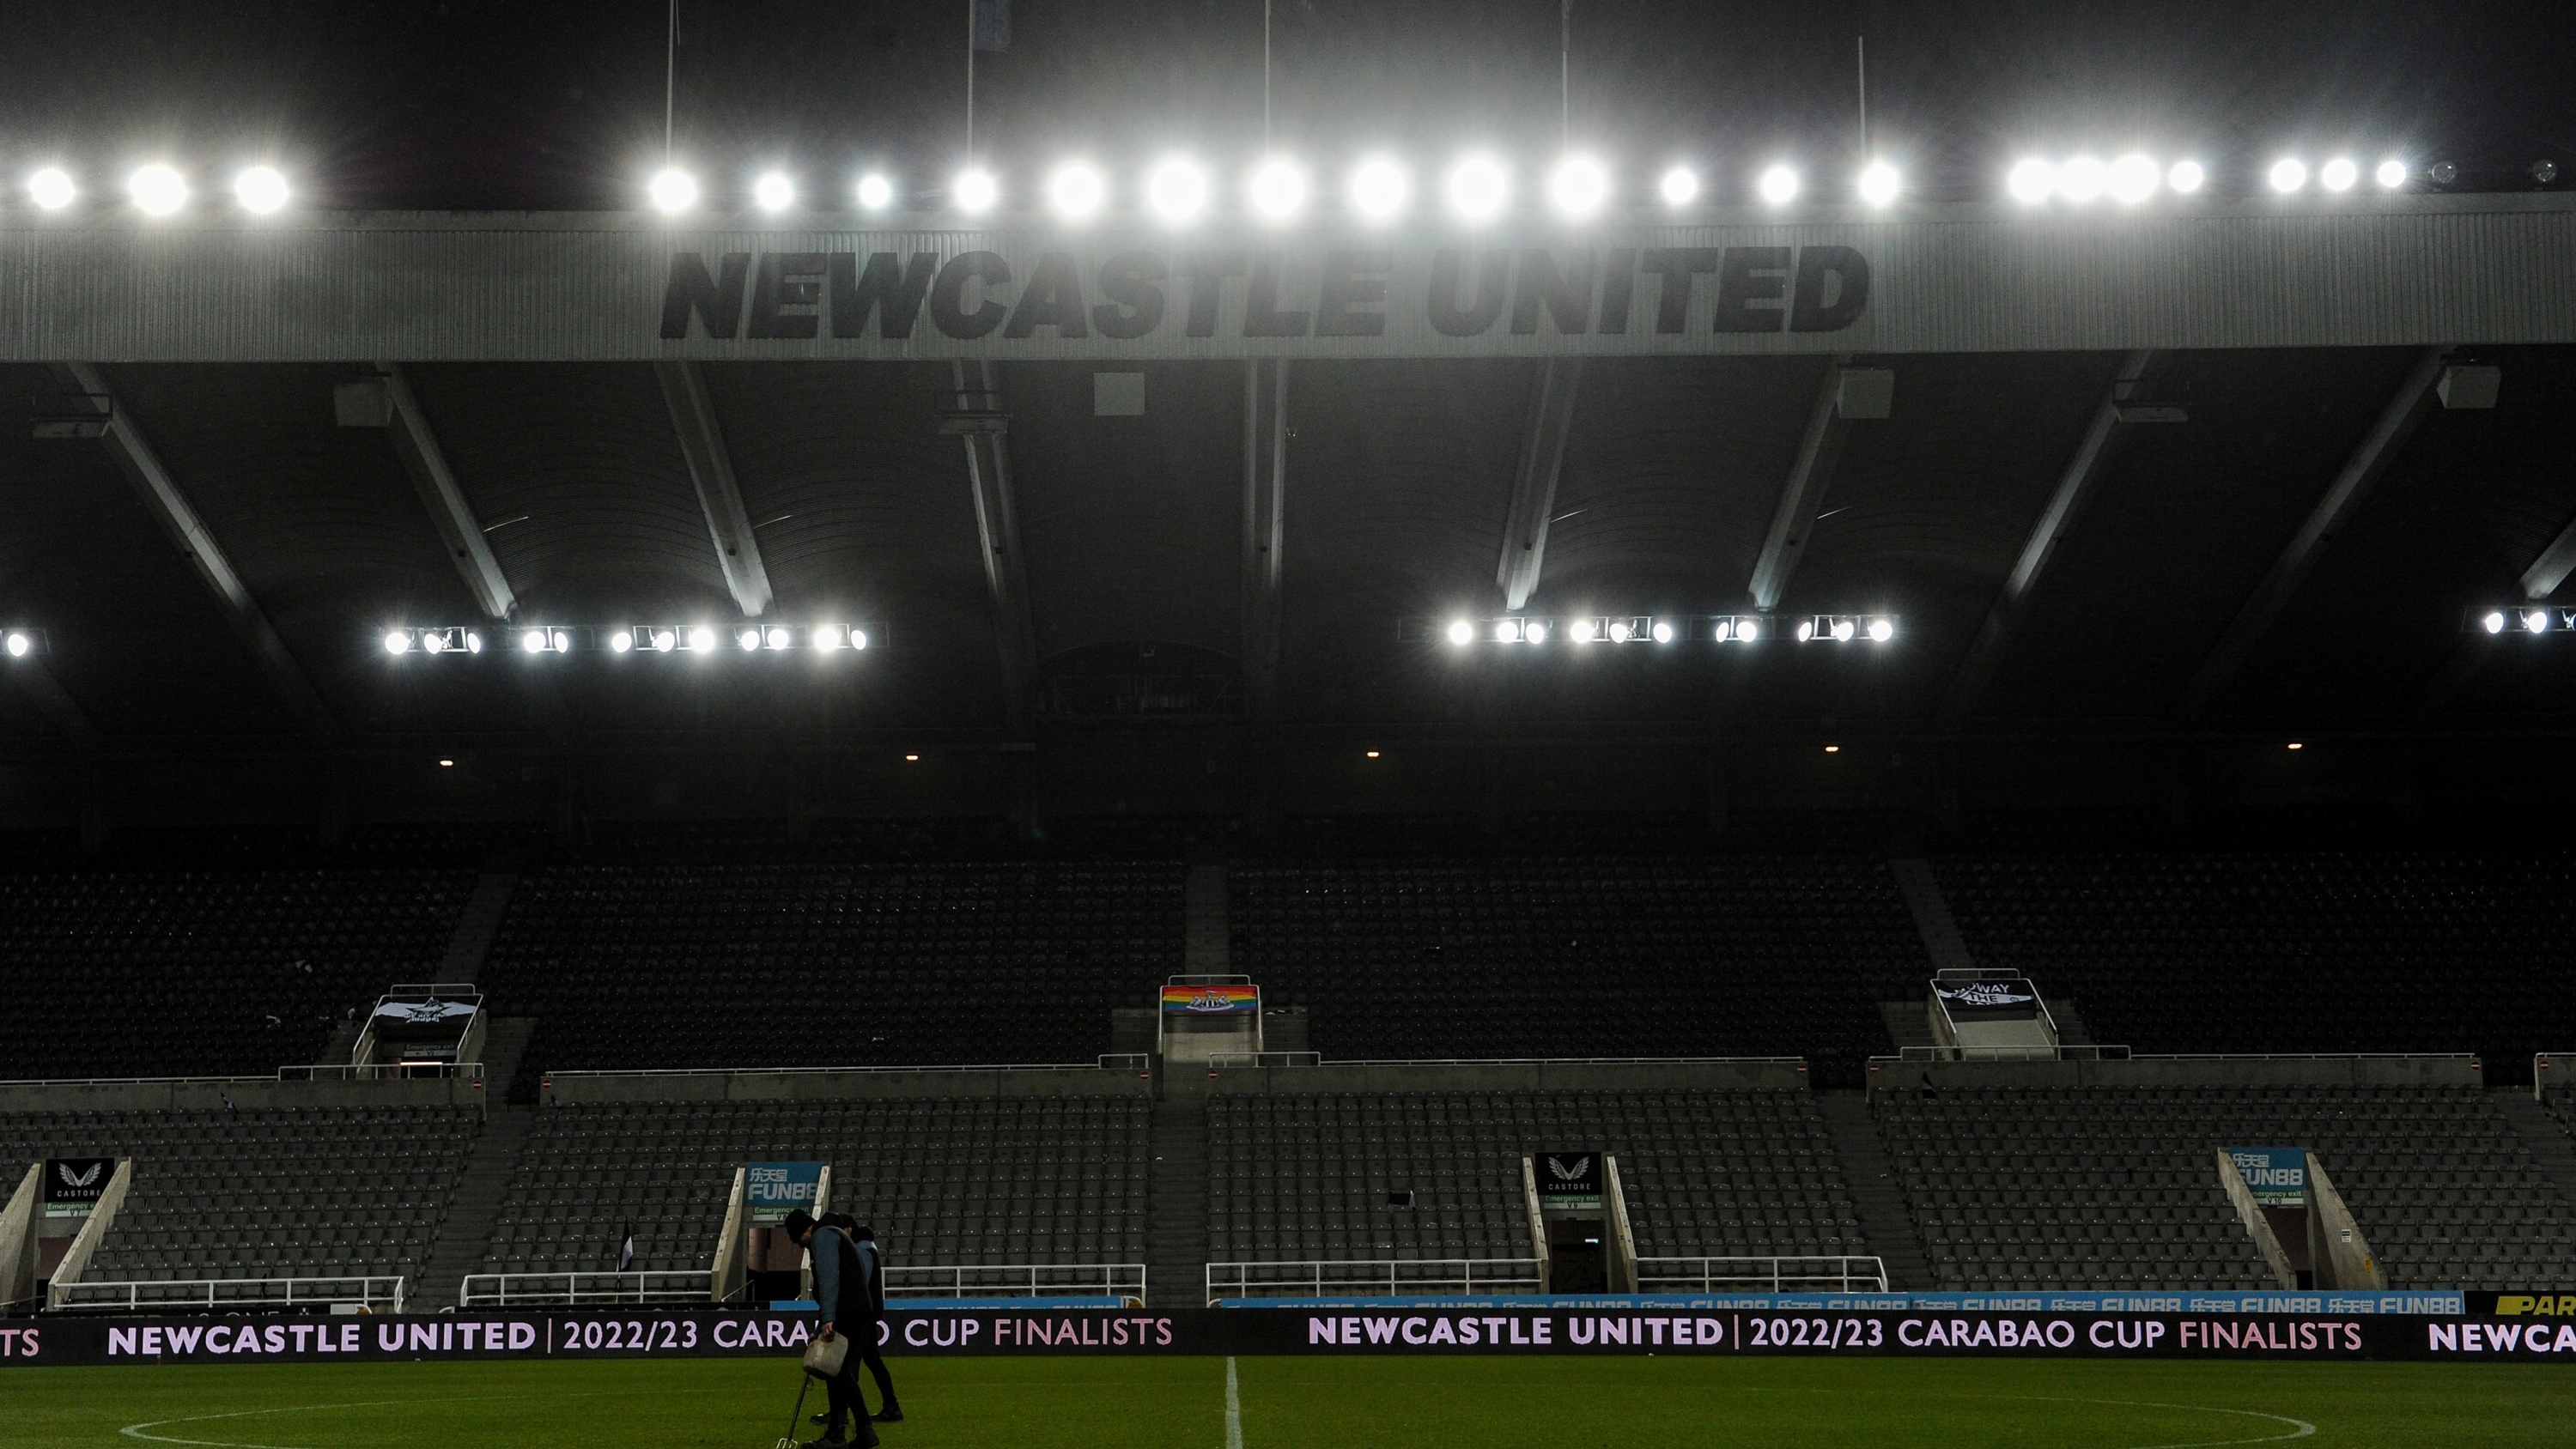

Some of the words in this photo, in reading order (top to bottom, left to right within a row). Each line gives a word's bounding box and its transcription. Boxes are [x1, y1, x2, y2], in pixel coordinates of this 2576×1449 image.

[660, 247, 1391, 340] NEWCASTLE
[1428, 246, 1870, 336] UNITED
[1969, 991, 1998, 1002] THE
[46, 1203, 88, 1211] Emergency
[2241, 1297, 2321, 1313] FUN88
[2379, 1297, 2461, 1315] FUN88
[108, 1324, 361, 1355] NEWCASTLE
[378, 1322, 536, 1352] UNITED
[563, 1320, 697, 1352] 2022/23
[904, 1319, 980, 1347] CUP
[994, 1318, 1173, 1346] FINALISTS
[1309, 1316, 1552, 1345] NEWCASTLE
[1569, 1317, 1723, 1345] UNITED
[1750, 1318, 1883, 1349] 2022/23
[1898, 1319, 2075, 1348] CARABAO
[2089, 1320, 2166, 1349] CUP
[2179, 1321, 2361, 1350] FINALISTS
[2428, 1323, 2576, 1353] NEWCA
